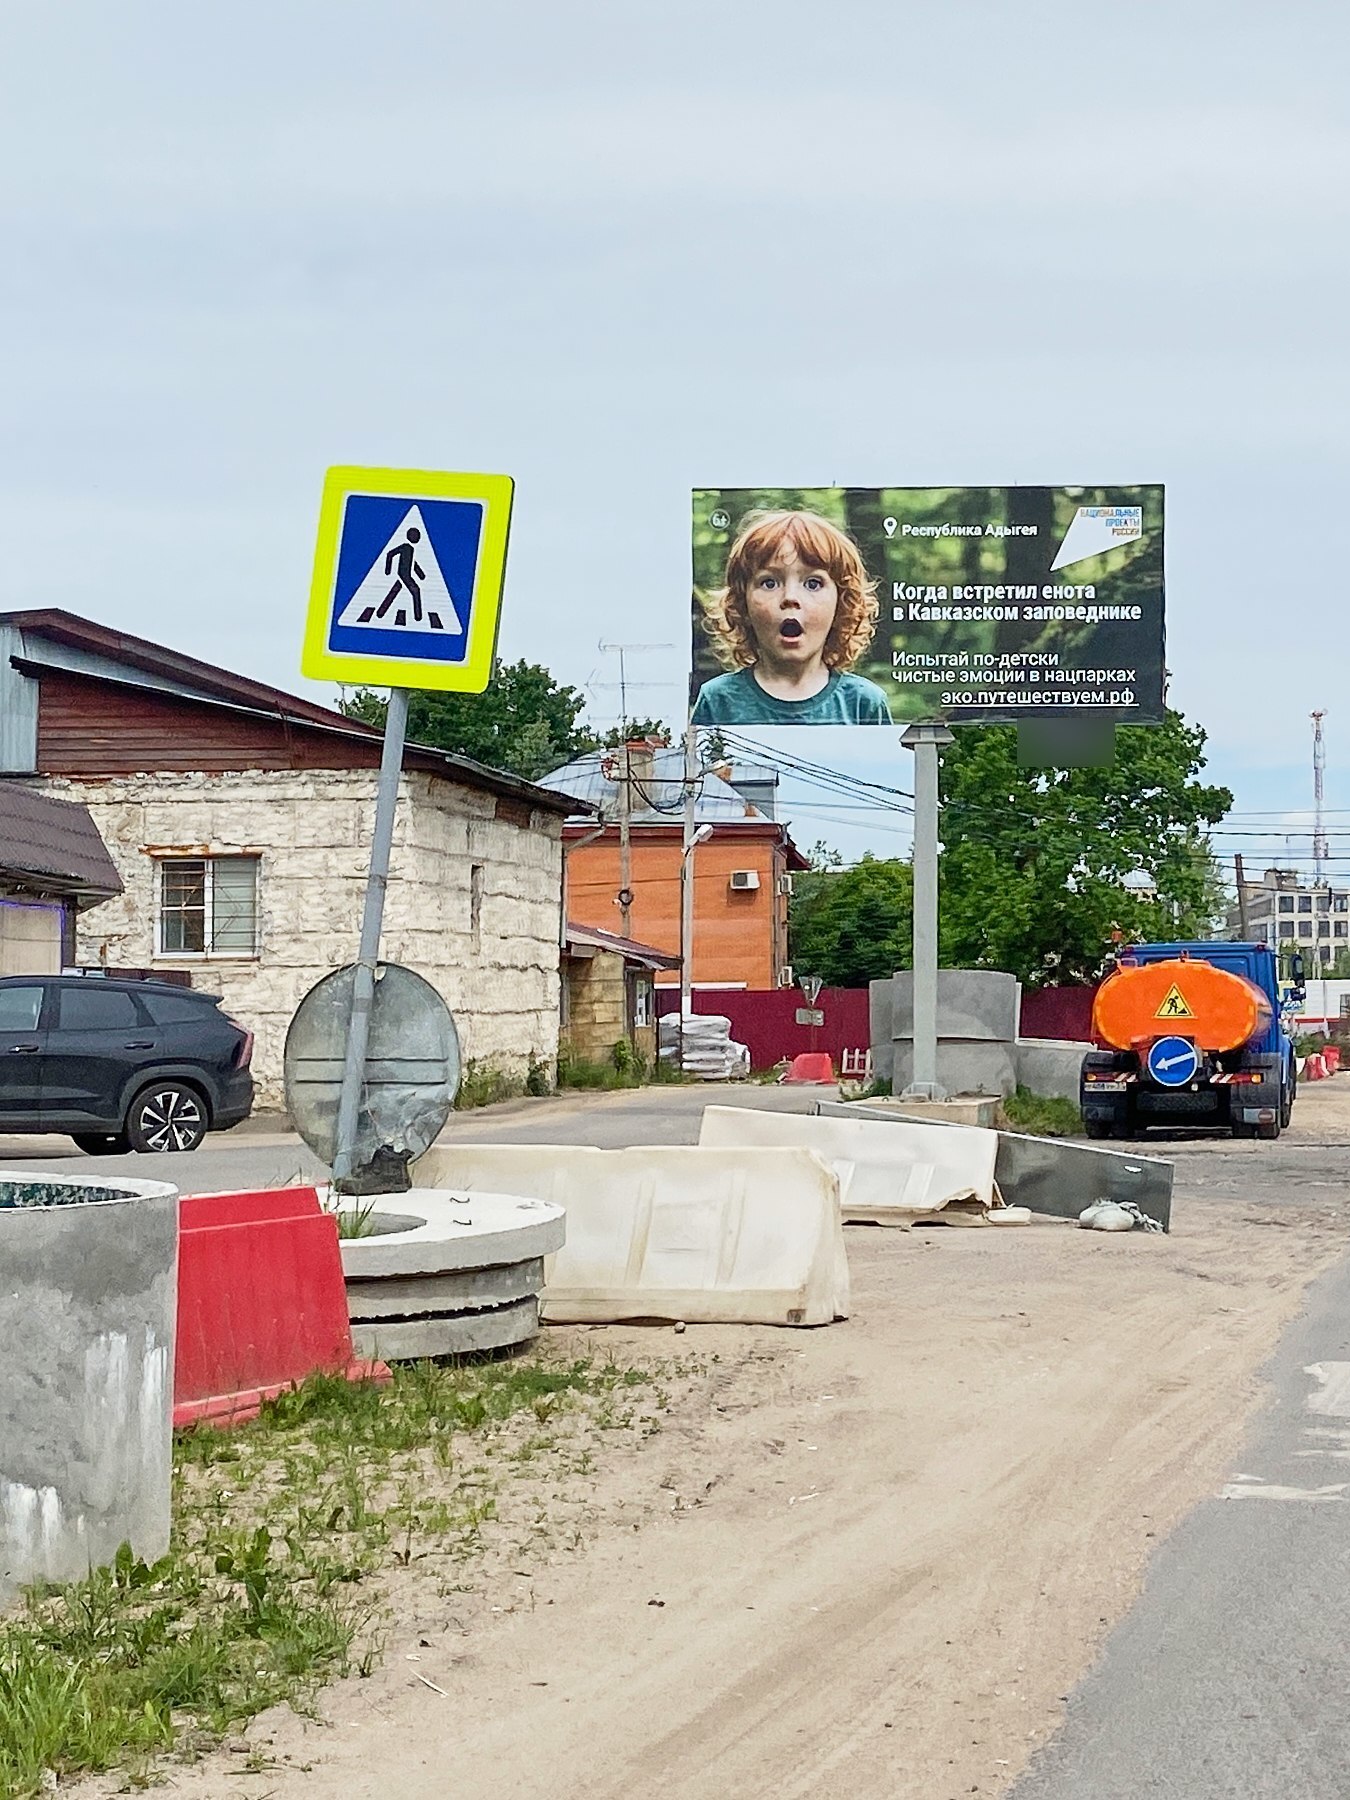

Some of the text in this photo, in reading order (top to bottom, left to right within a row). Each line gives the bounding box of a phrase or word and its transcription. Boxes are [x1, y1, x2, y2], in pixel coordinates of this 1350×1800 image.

[901, 524, 1038, 538] Республика Адыгея
[893, 582, 1096, 603] Когда встретил енота
[893, 603, 1142, 624] в Кавказском заповеднике
[892, 651, 1059, 669] Испытай по-детски
[892, 669, 1136, 686] чистые эмоции в нацпарках
[941, 687, 1135, 706] эко.путешествуем.рф
